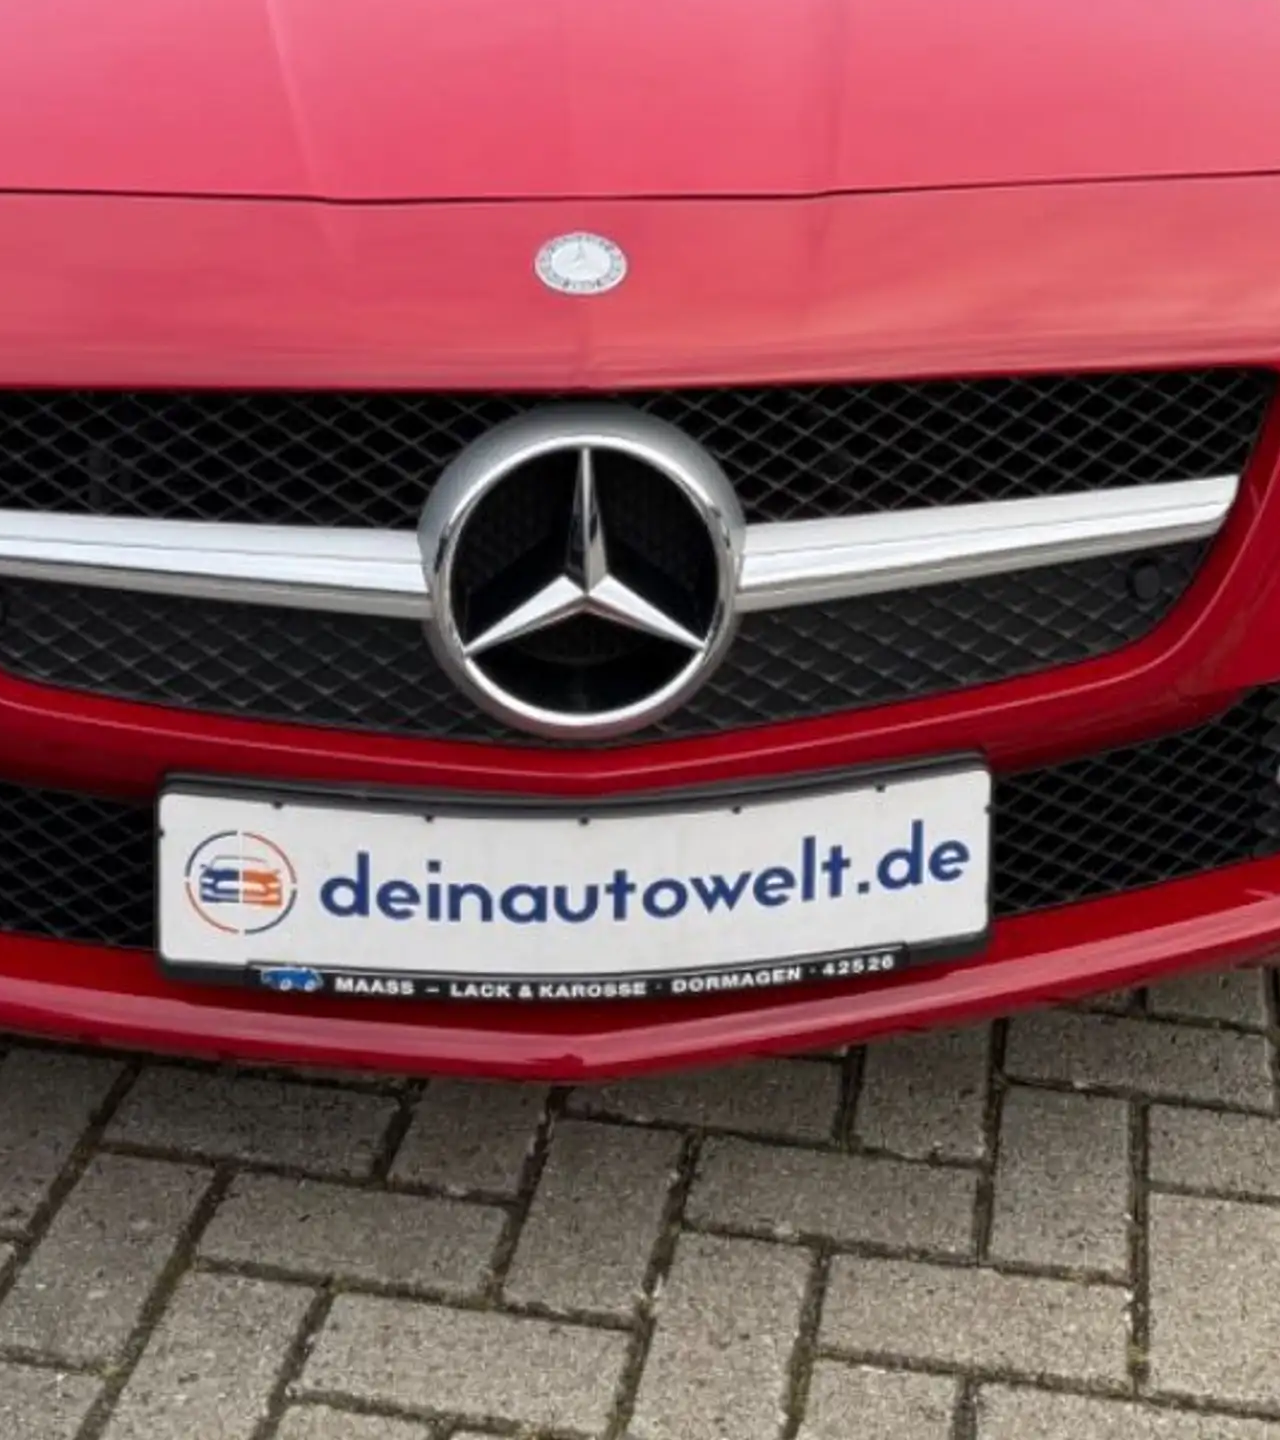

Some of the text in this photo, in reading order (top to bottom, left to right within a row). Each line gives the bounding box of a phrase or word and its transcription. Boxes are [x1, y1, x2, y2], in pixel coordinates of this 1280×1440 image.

[320, 820, 970, 923] deinautowelt.de
[334, 976, 415, 996] MAASS
[450, 983, 511, 998] LACK
[539, 980, 647, 998] KAROSSE
[671, 966, 802, 993] DORMAGEN
